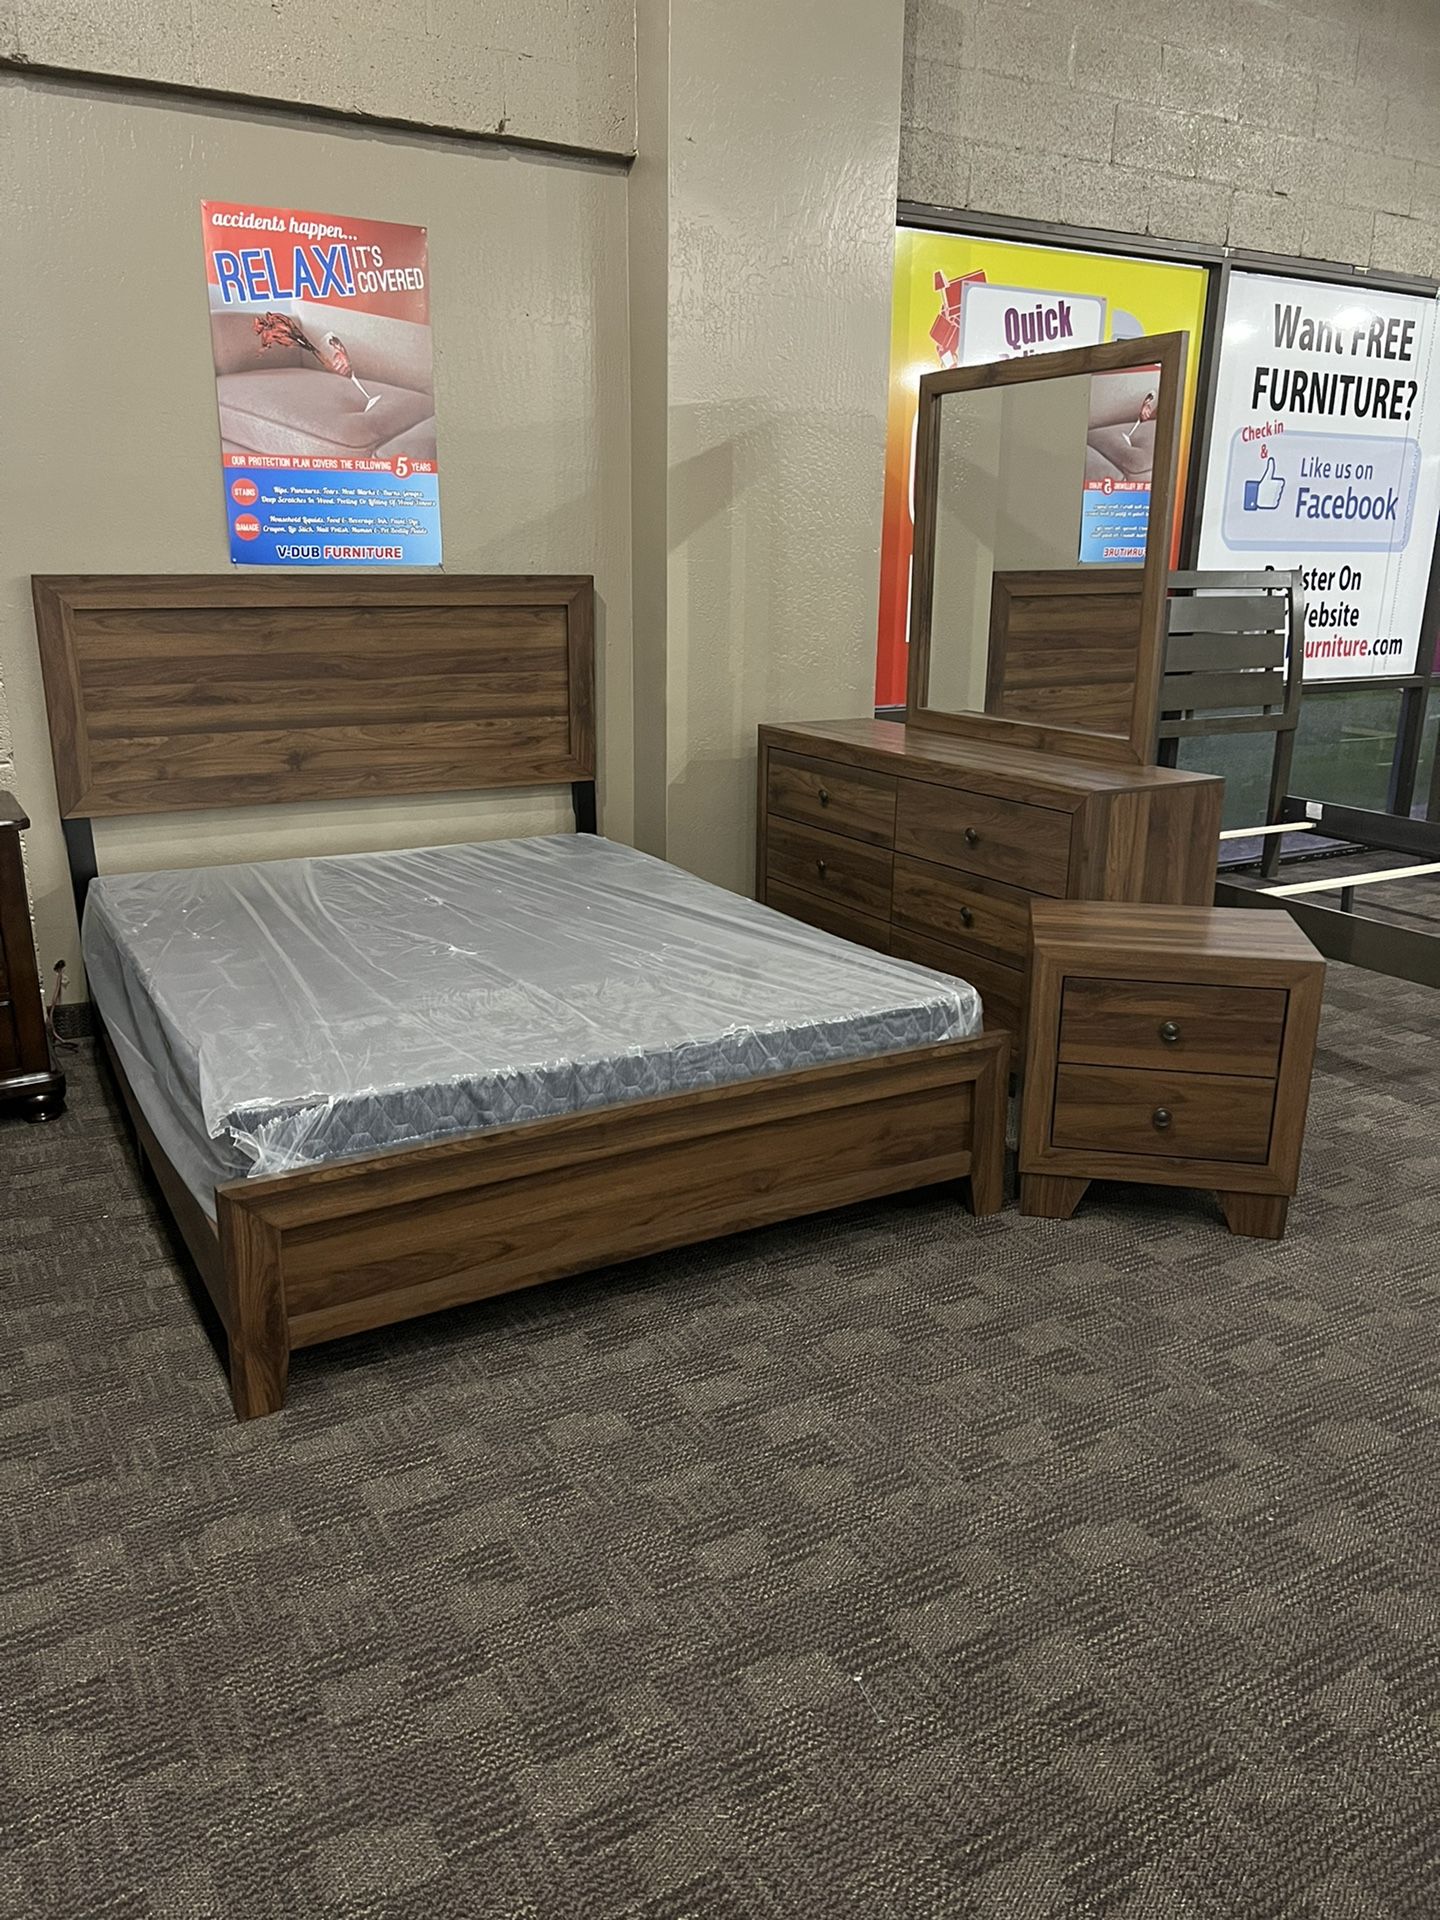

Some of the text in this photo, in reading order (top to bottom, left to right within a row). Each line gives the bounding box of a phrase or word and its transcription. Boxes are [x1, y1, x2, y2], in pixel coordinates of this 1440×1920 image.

[211, 212, 358, 241] accidents happen...
[351, 245, 384, 269] IT'S
[213, 243, 357, 304] RELAX!
[357, 268, 425, 293] COVERED
[1004, 300, 1074, 350] Quick
[1274, 303, 1416, 362] Want FREE
[1251, 366, 1418, 421] FURNITURE?
[1241, 420, 1285, 442] Check in
[1260, 443, 1269, 459] &
[231, 456, 432, 477] OUR PROTECTION PLAN COVERS THE FOLLOWING 5 YEARS
[1300, 456, 1374, 480] Like us on
[234, 488, 256, 496] STAINS
[1295, 486, 1399, 521] Facebook
[235, 523, 260, 532] DAMAGE
[276, 545, 403, 560] V-DUB FURNITURE
[1339, 565, 1362, 591] On
[1303, 601, 1360, 628] ebsite
[1304, 634, 1403, 659] urniture.com
